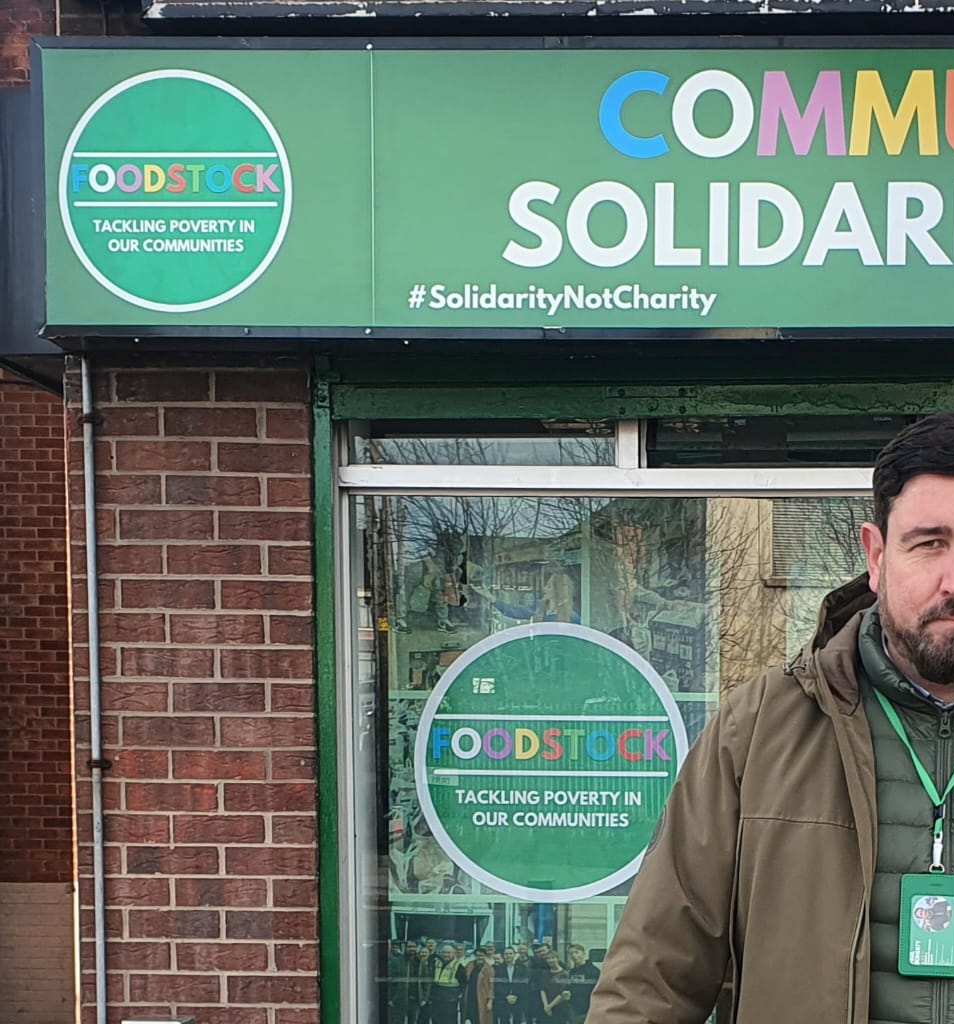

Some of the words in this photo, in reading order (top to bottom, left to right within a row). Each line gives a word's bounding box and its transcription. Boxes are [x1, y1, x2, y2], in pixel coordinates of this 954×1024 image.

[71, 163, 280, 195] FOODSTOCK
[93, 218, 165, 235] TACKLING
[169, 218, 236, 235] POVERTY
[239, 218, 256, 234] IN
[107, 237, 140, 254] OUR
[142, 237, 244, 254] COMMUNITIES
[407, 283, 717, 319] #SolidarityNotCharity
[431, 726, 671, 762] FOODSTOCK
[455, 789, 540, 806] TACKLING
[544, 790, 620, 807] POVERTY
[624, 791, 642, 807] IN
[472, 811, 509, 827] OUR
[512, 812, 629, 828] COMMUNITIES
